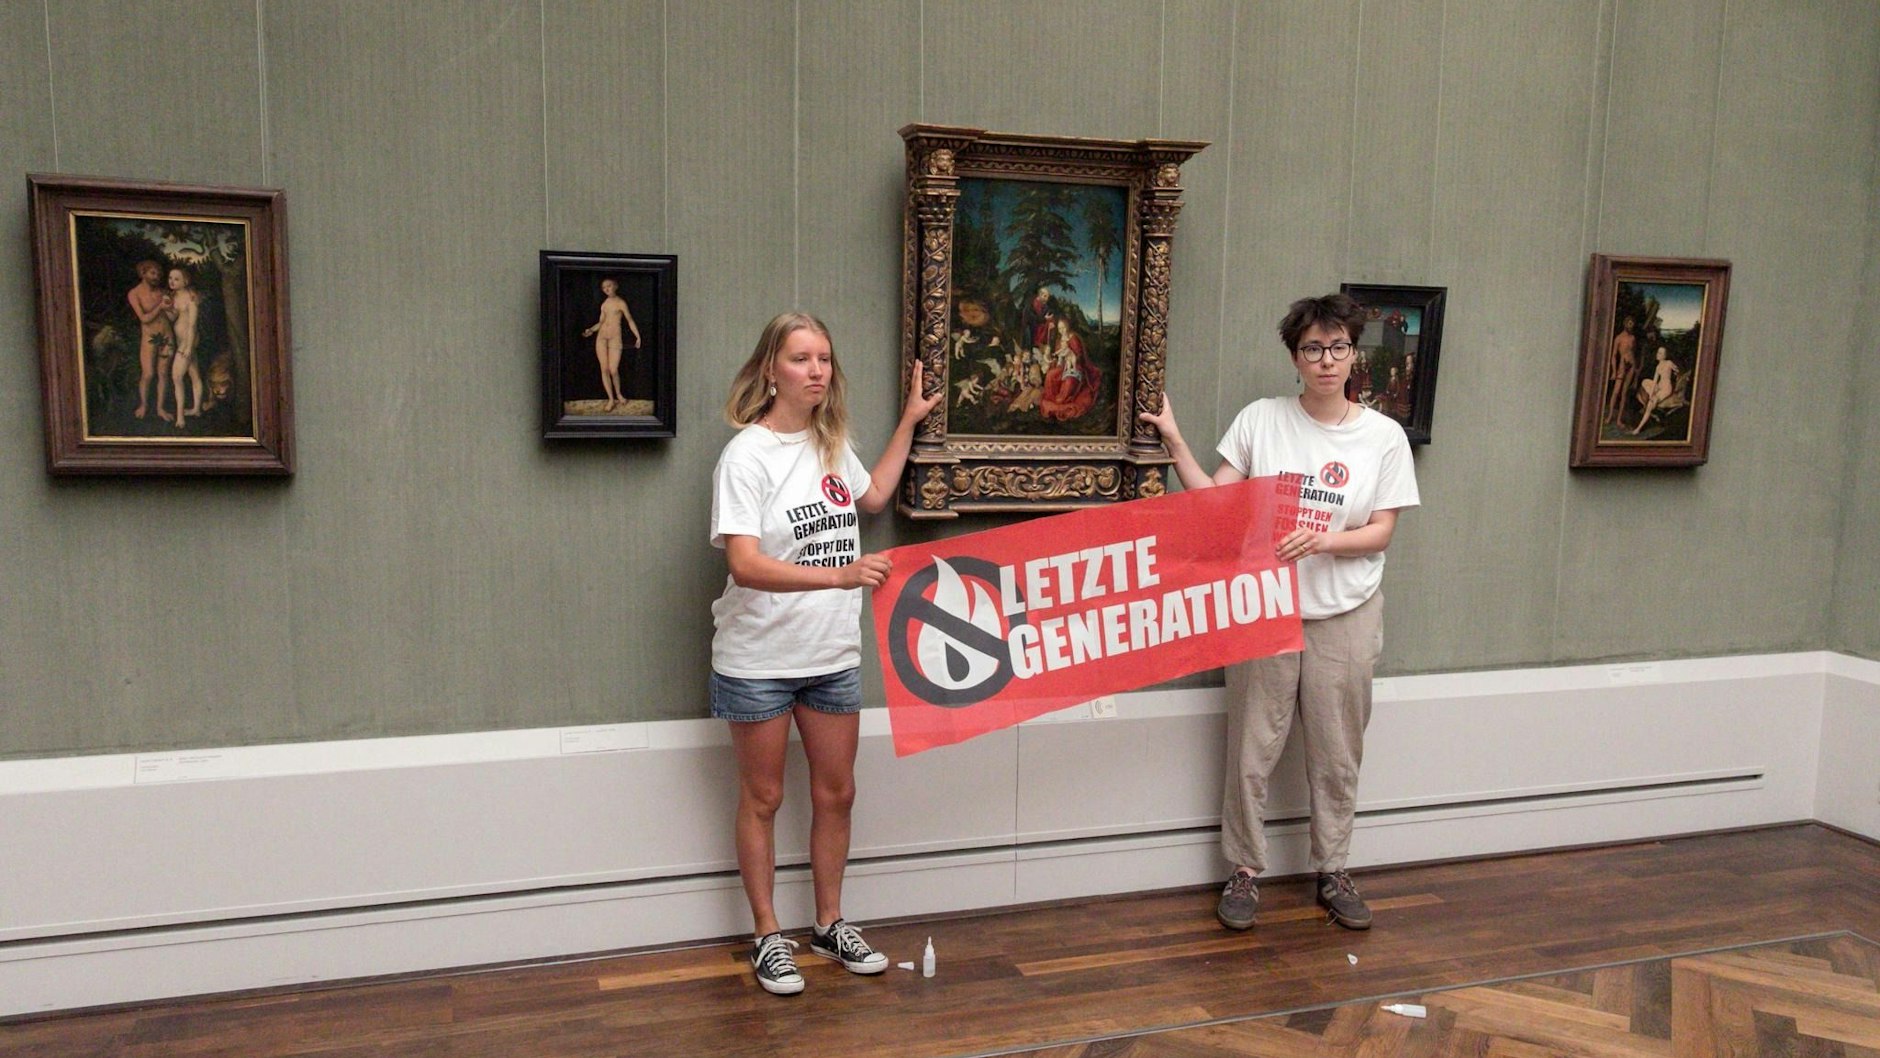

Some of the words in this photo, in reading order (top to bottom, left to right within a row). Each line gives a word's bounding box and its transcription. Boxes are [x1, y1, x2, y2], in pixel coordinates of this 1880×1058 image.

[1278, 470, 1315, 487] LETZTE
[1275, 483, 1345, 506] GENERATION
[786, 501, 828, 523] LETZTE
[1277, 504, 1314, 519] STOPPT
[1314, 510, 1334, 522] DEN
[836, 538, 854, 552] DEN
[1000, 535, 1160, 616] LETZTE
[1008, 566, 1295, 680] GENERATION
